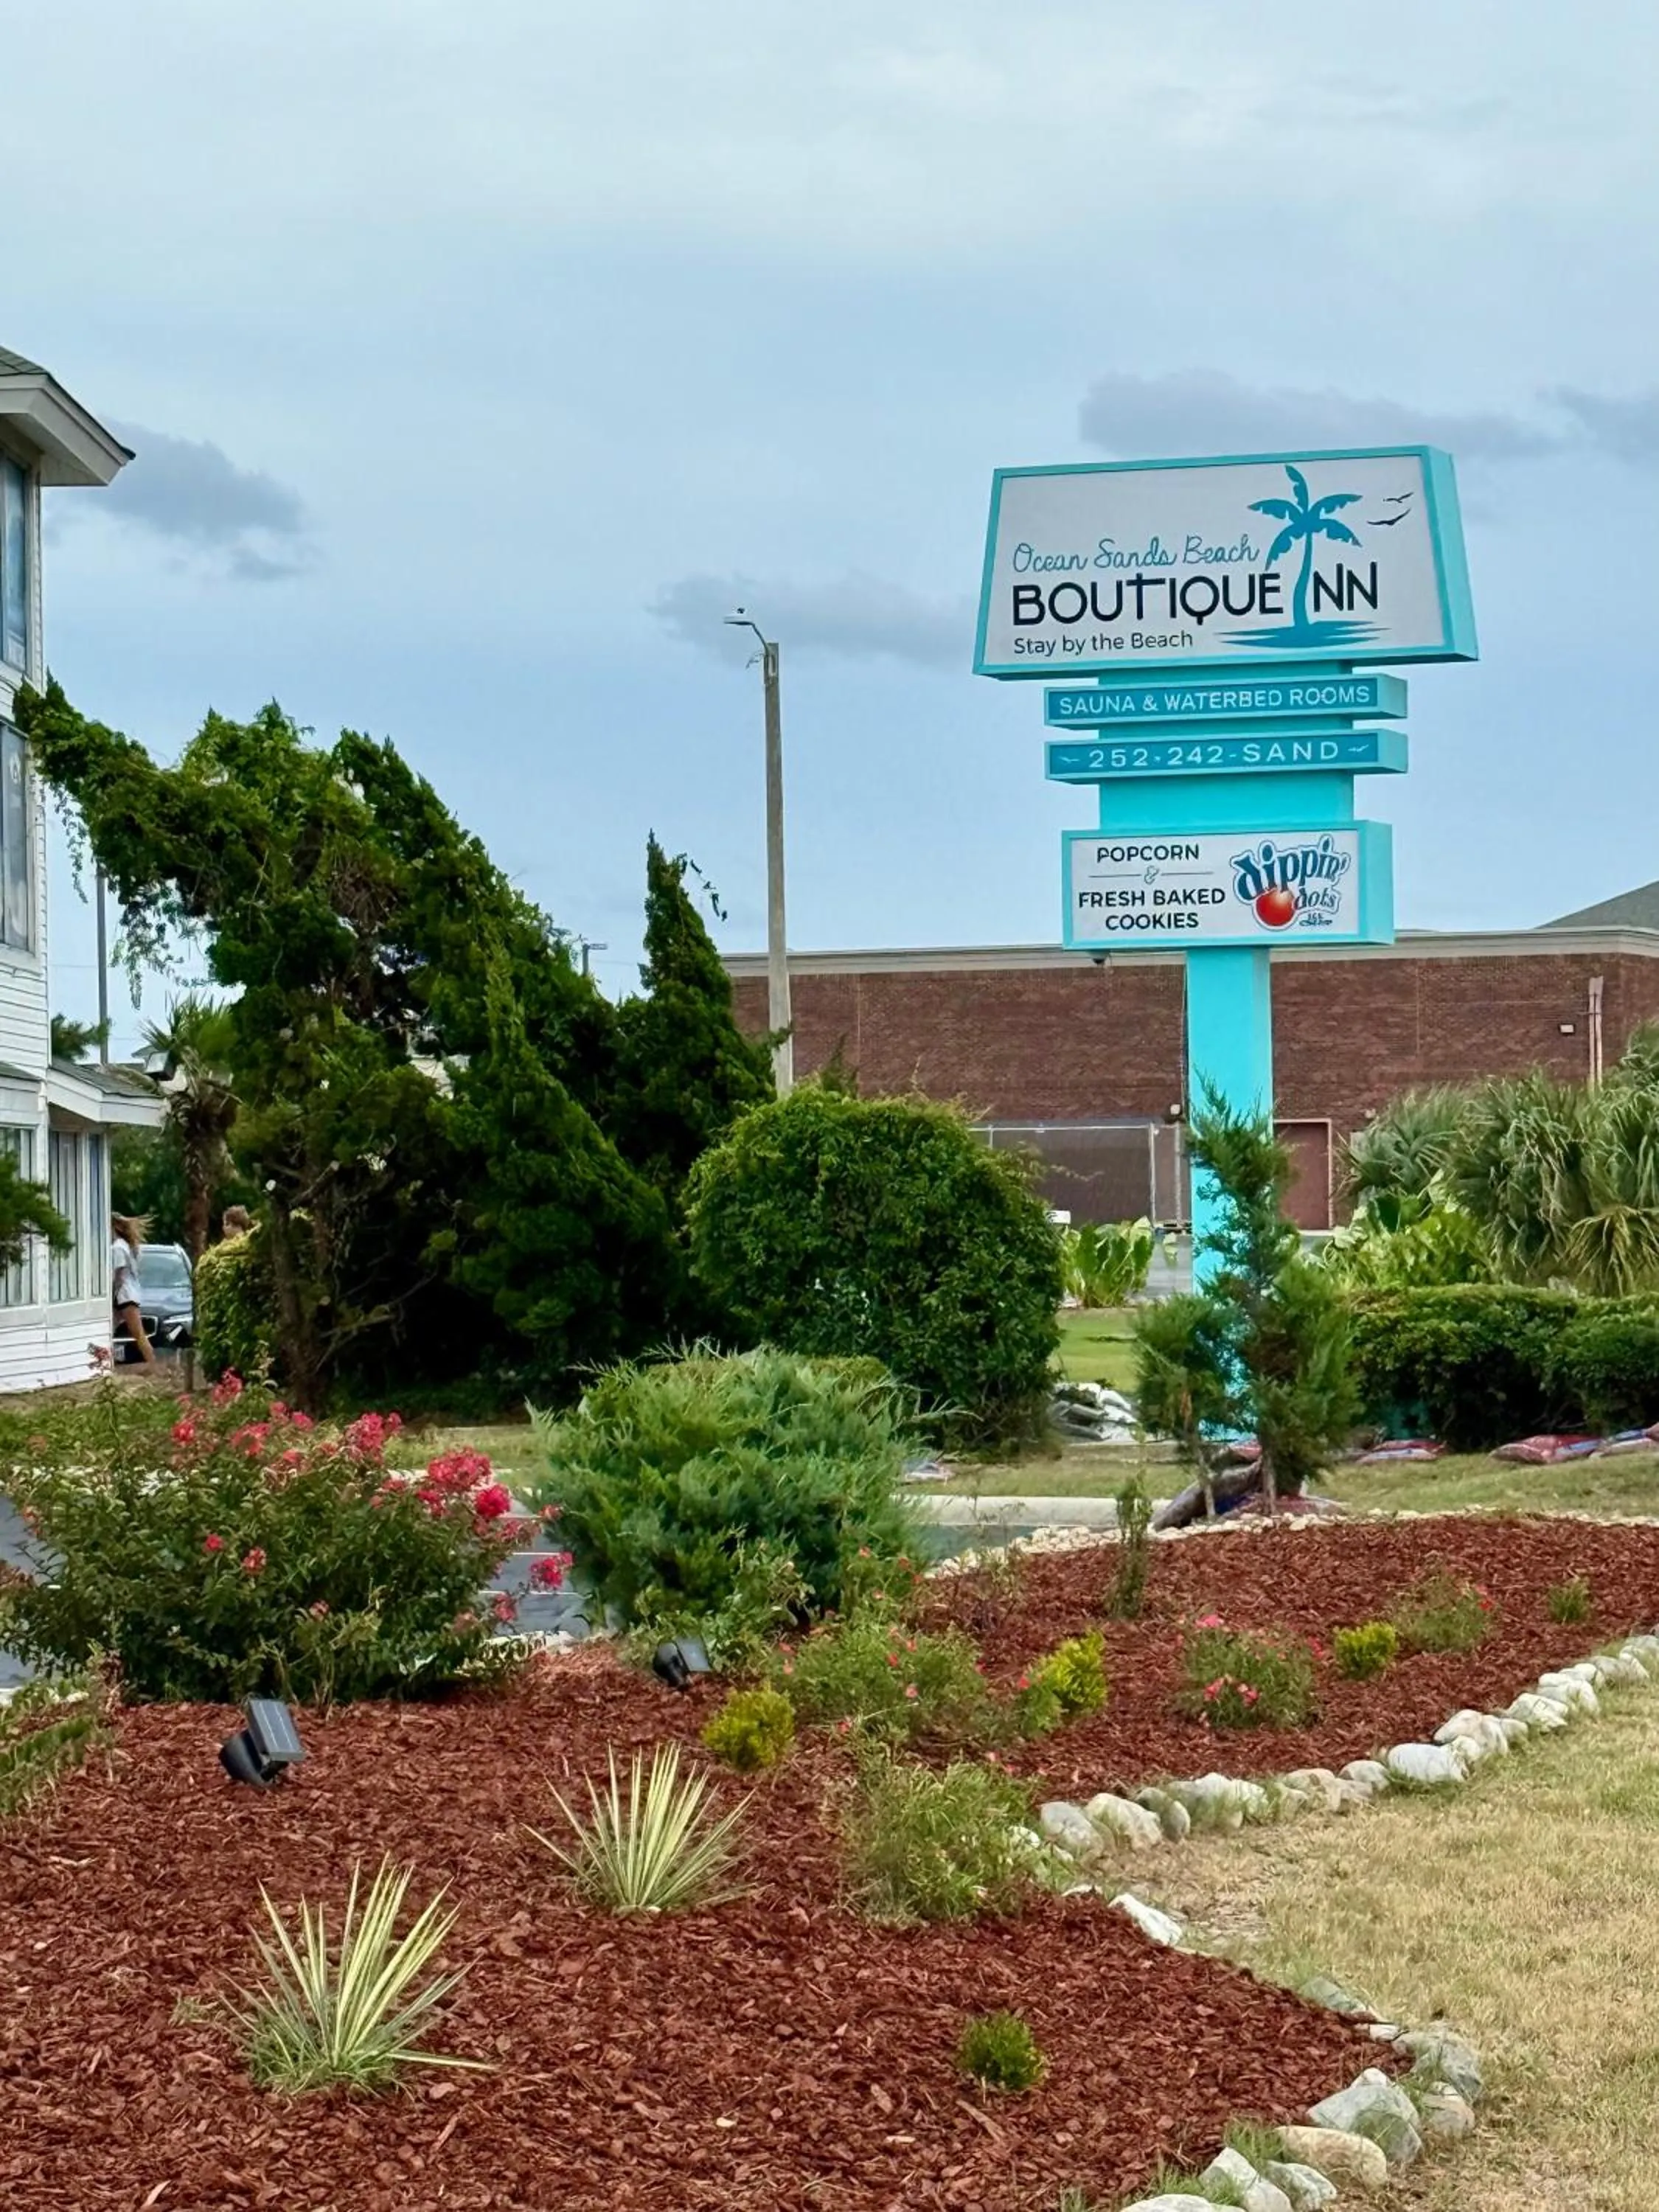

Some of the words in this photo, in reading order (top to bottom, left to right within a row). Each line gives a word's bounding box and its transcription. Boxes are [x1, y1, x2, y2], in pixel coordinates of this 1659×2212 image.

[1013, 542, 1088, 574] Ocean
[1094, 536, 1177, 569] Sands
[1182, 533, 1260, 564] Beach
[1013, 572, 1283, 627] BOUTIQUE
[1014, 636, 1057, 655] Stay
[1062, 635, 1085, 655] by
[1091, 633, 1124, 651] the
[1130, 630, 1193, 649] Beach
[1060, 695, 1135, 715] SAUNA
[1143, 694, 1158, 712] &
[1165, 689, 1283, 710] WATERBED
[1290, 685, 1371, 706] ROOMS
[1096, 844, 1200, 863] POPCORN
[1078, 890, 1145, 909] FRESH
[1152, 887, 1226, 906] BAKED
[1295, 887, 1338, 910] dots
[1105, 911, 1199, 931] COOKIES
